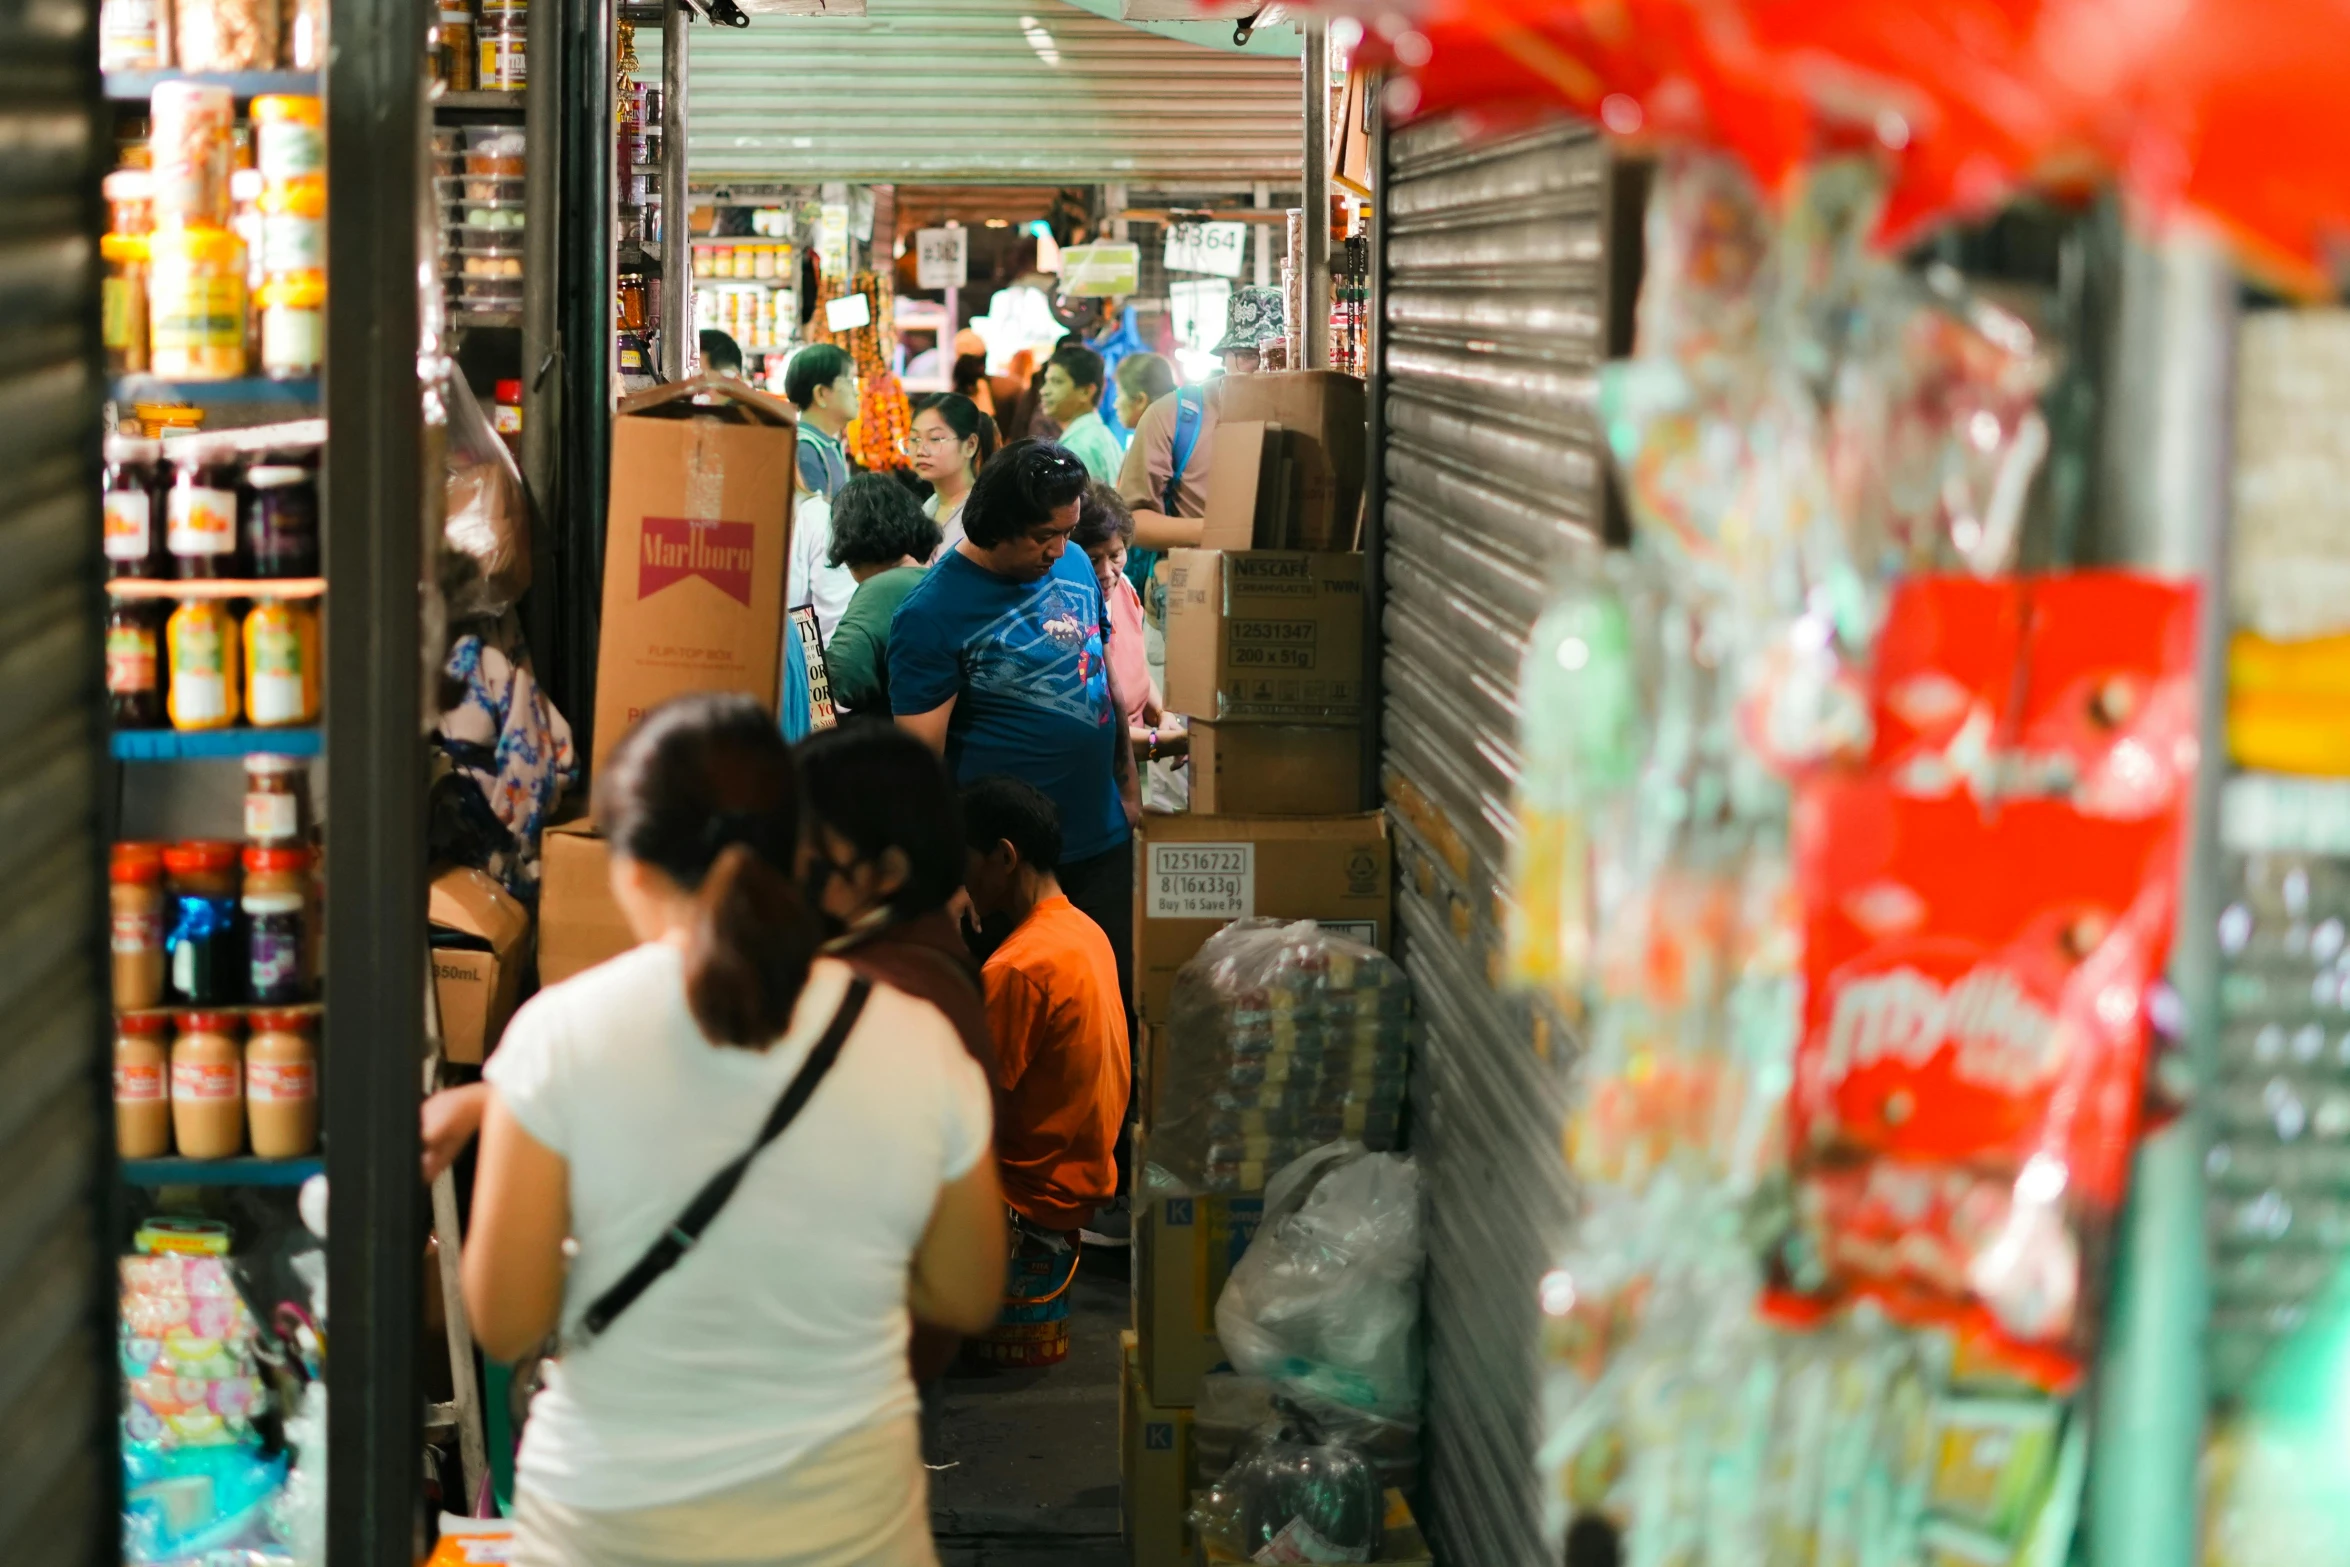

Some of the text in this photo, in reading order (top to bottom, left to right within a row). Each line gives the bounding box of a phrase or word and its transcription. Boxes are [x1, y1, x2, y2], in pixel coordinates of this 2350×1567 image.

[643, 527, 751, 572] Marlboro
[1233, 623, 1313, 640] 12531347
[1235, 649, 1309, 667] 200 x 51g
[1163, 853, 1241, 870] 12516722
[1159, 898, 1243, 912] Buy 16 Save P9
[1171, 1200, 1189, 1223] K
[1151, 1426, 1168, 1447] K
